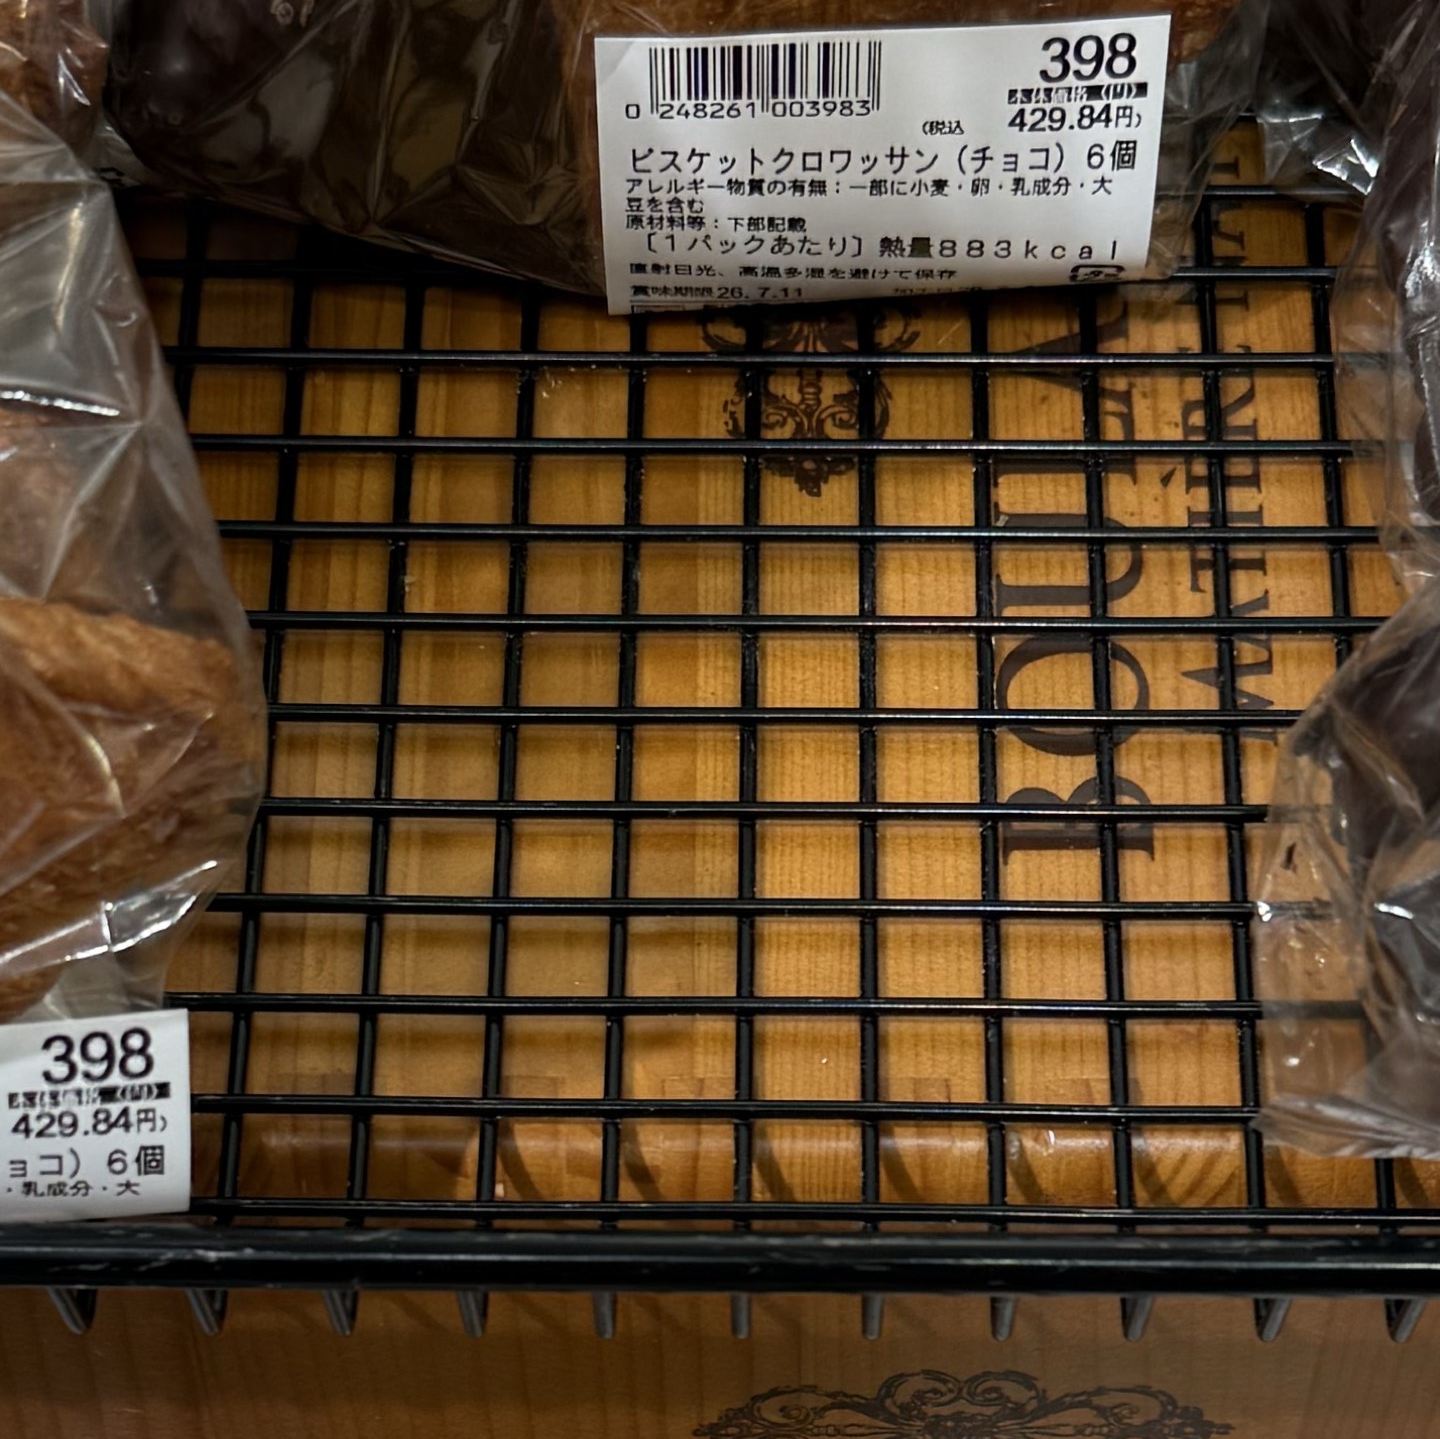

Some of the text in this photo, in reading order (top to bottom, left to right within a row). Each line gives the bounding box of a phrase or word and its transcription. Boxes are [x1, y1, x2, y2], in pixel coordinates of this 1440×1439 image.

[1040, 33, 1137, 83] 398
[626, 99, 871, 120] 0 248261 003983
[1008, 103, 1142, 132] 429.84円)
[626, 197, 704, 213] 豆を含む
[41, 1028, 155, 1084] 398
[10, 1107, 167, 1139] 429.84円)
